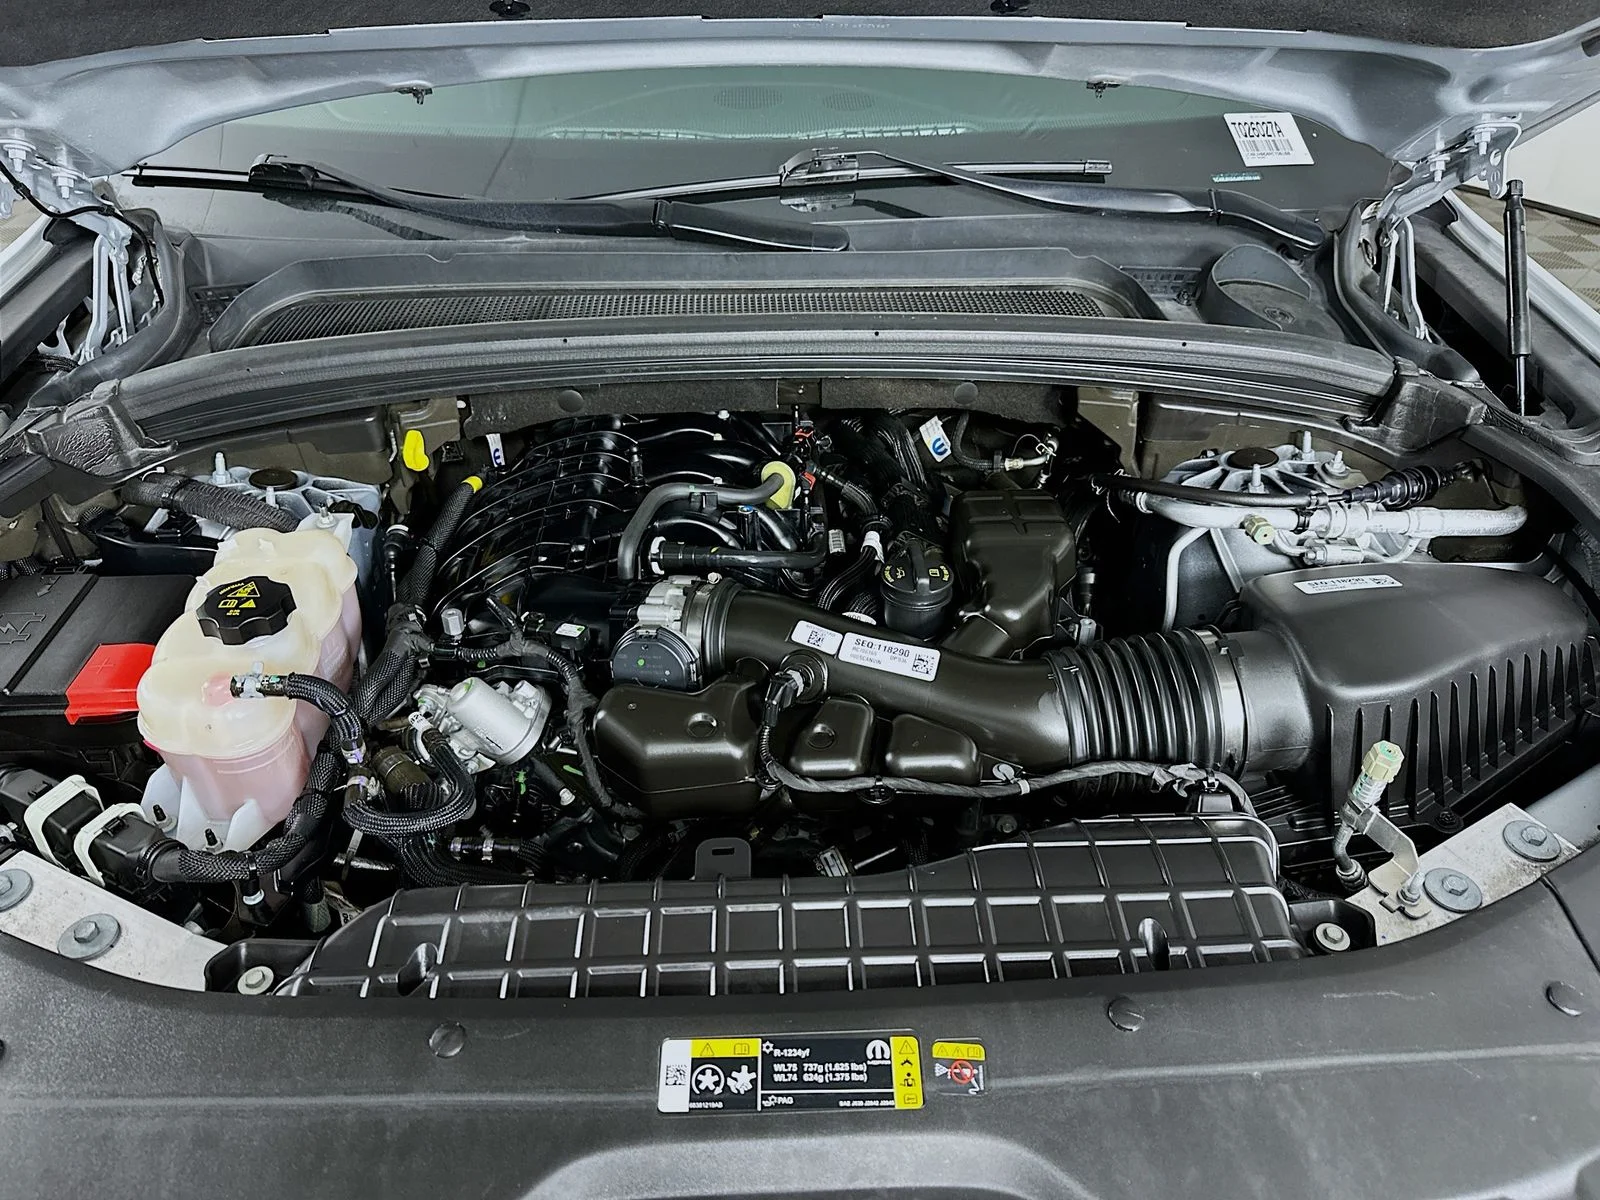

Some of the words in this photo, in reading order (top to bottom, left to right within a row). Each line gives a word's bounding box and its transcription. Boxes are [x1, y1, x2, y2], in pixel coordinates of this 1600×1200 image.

[854, 638, 910, 658] SEQ:118290
[773, 1048, 811, 1059] R-1234yf
[773, 1063, 798, 1072] WL75
[803, 1063, 824, 1073] 737g
[850, 1062, 868, 1073] lbs)
[773, 1073, 798, 1082] WL74
[802, 1073, 824, 1084] 624g
[850, 1072, 868, 1083] lbs)
[777, 1096, 794, 1105] PAG
